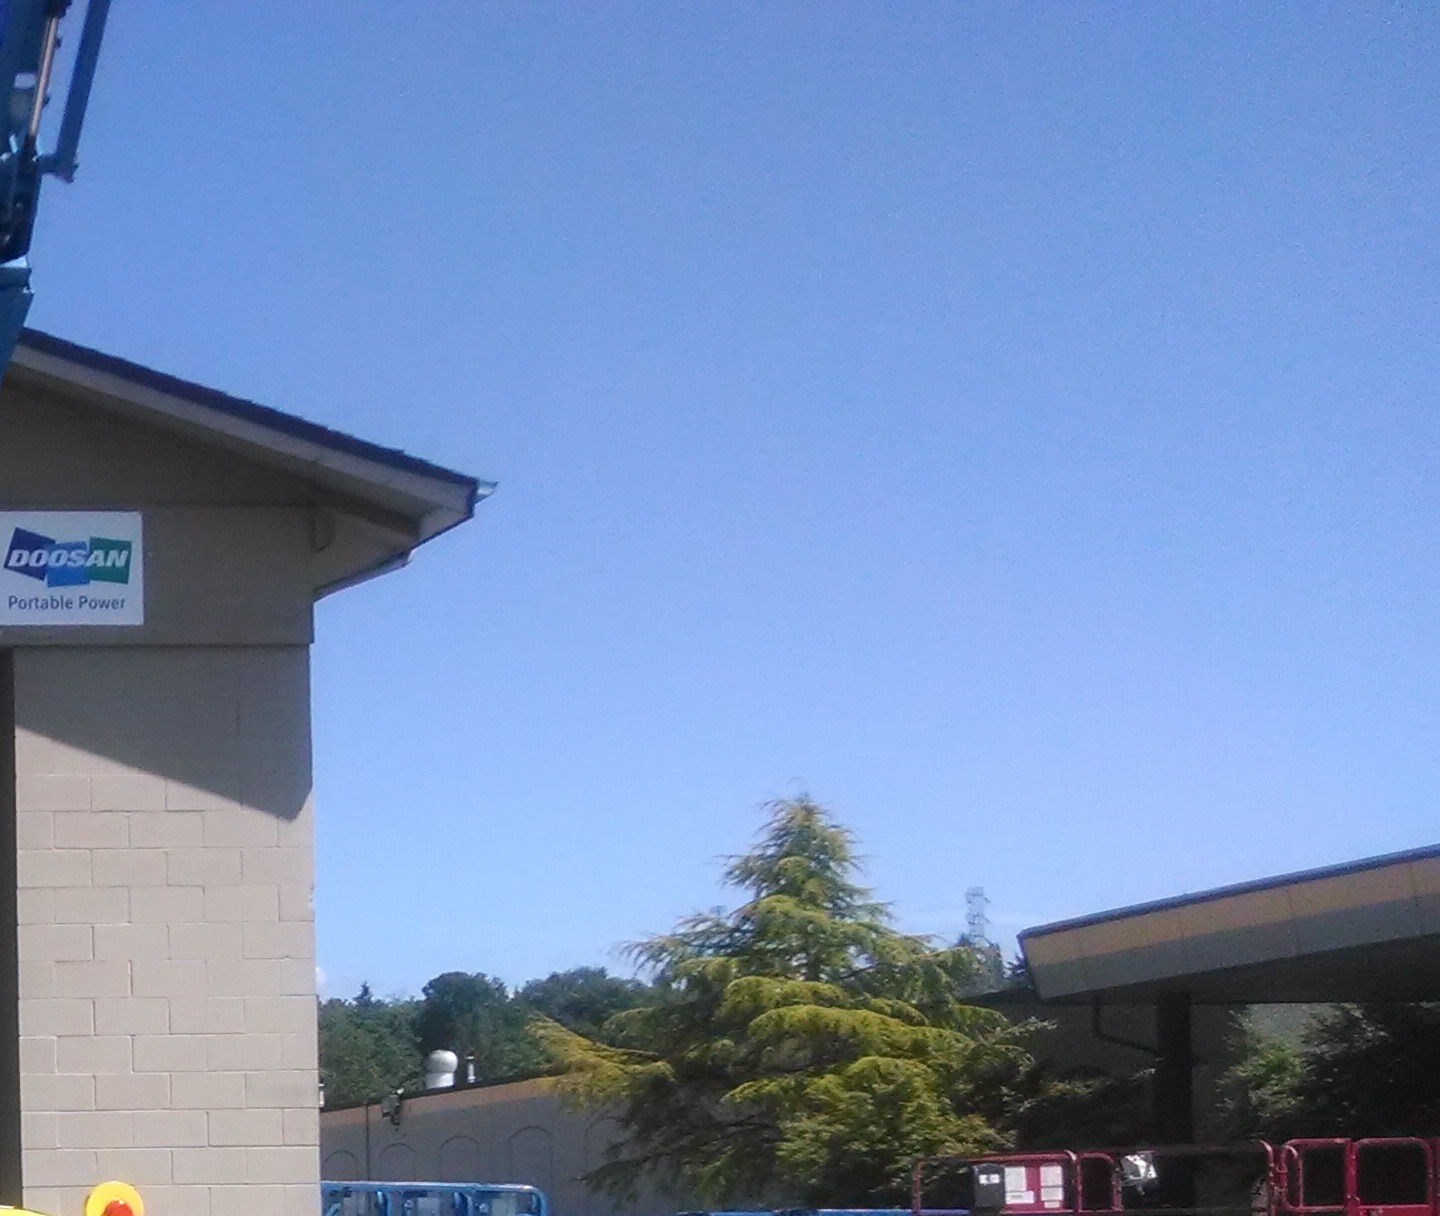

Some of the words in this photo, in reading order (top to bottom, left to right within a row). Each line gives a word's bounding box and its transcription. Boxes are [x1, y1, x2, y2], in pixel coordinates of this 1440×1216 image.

[7, 549, 129, 568] DOOSAN
[7, 594, 74, 610] Portable
[78, 594, 126, 610] Power
